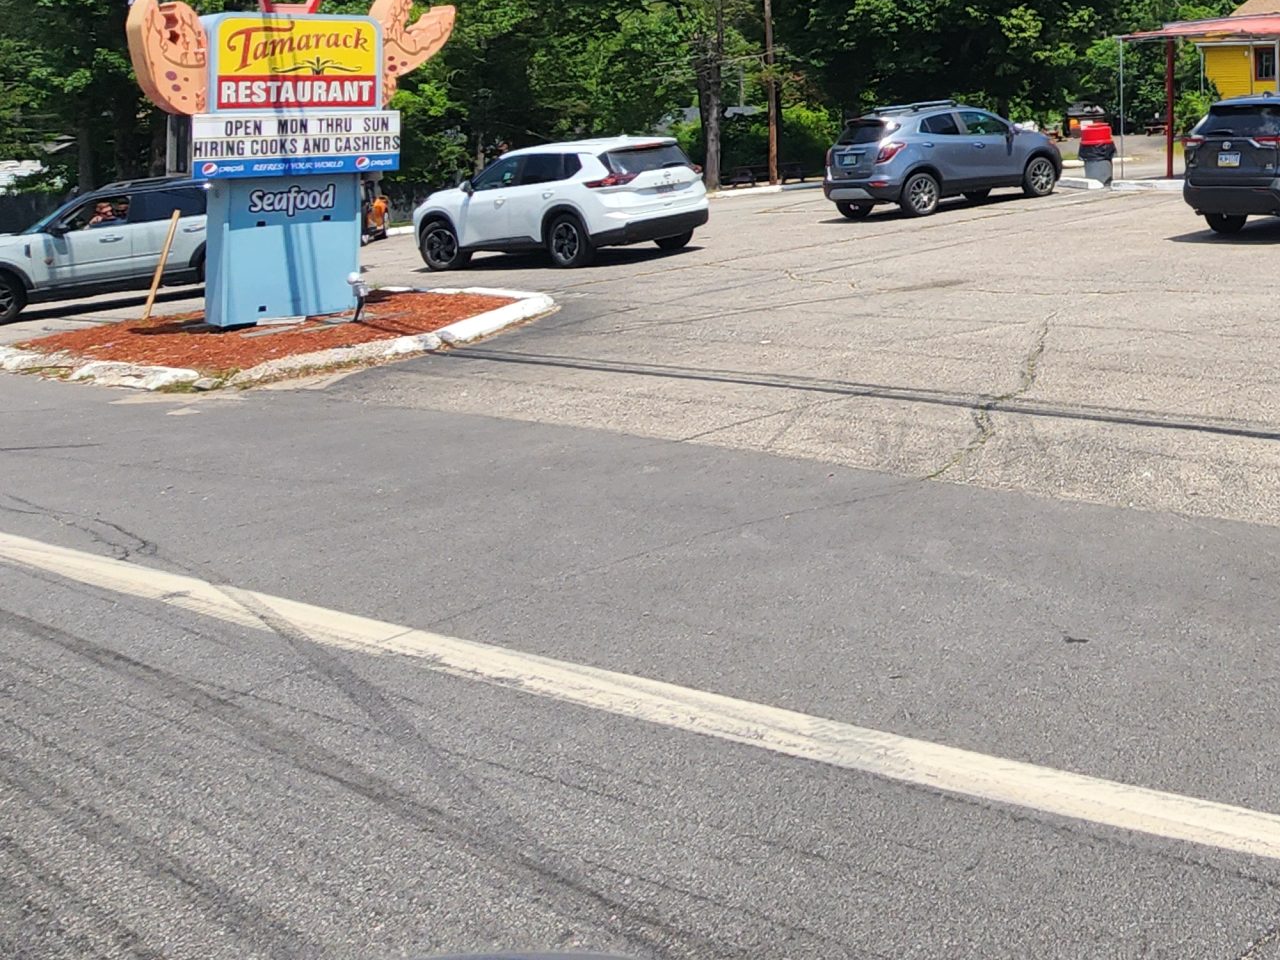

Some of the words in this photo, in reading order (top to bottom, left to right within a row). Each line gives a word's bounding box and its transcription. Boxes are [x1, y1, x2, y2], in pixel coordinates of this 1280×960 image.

[226, 20, 370, 72] Tamarack
[221, 80, 373, 104] RESTAURANT
[225, 120, 262, 137] OPEN
[277, 118, 308, 135] MON
[317, 117, 352, 133] THRU
[363, 116, 389, 132] SUN
[193, 139, 244, 157] HIRING
[250, 138, 298, 155] COOKS
[302, 137, 330, 154] AND
[334, 135, 400, 153] CASHIERS
[218, 164, 244, 173] pepsi
[252, 163, 289, 172] REFRESH
[290, 161, 314, 171] YOUR
[315, 160, 344, 169] WORLD
[369, 158, 392, 168] pepsi
[249, 183, 335, 216] Seafood
